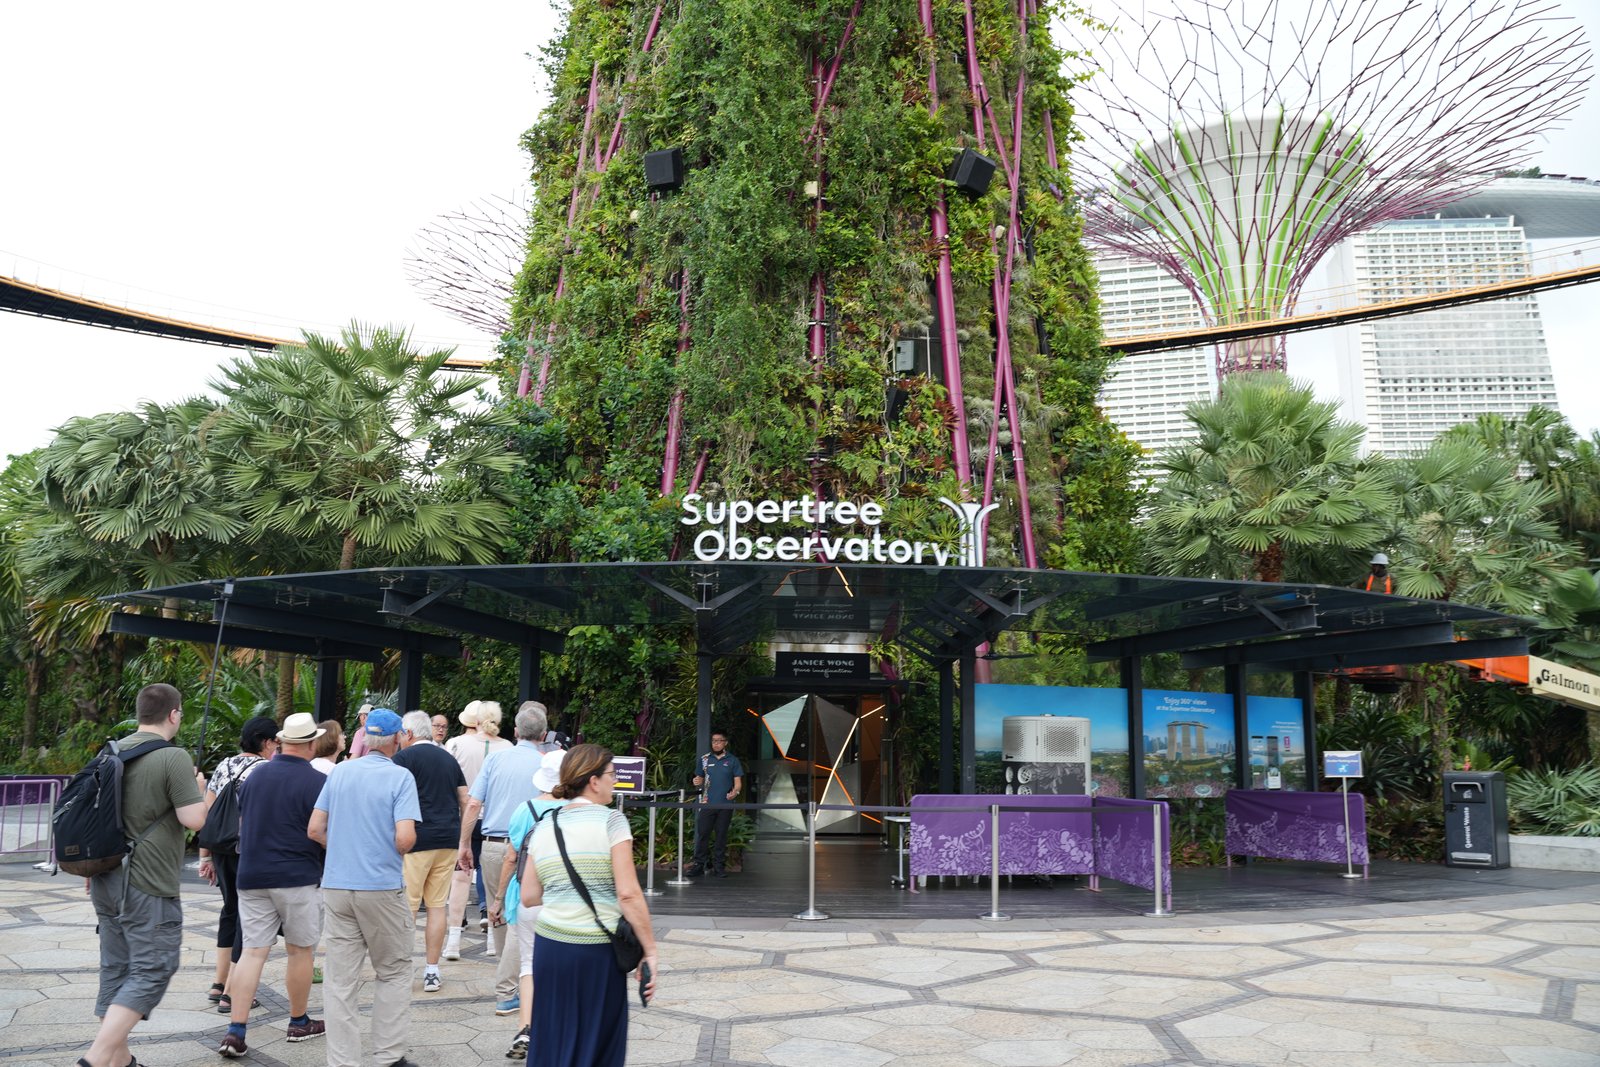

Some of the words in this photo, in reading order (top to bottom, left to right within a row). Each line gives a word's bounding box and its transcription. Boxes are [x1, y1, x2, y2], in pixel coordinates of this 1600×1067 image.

[681, 493, 883, 527] Supertree
[694, 526, 950, 566] Observatory
[1541, 668, 1591, 694] Galmon
